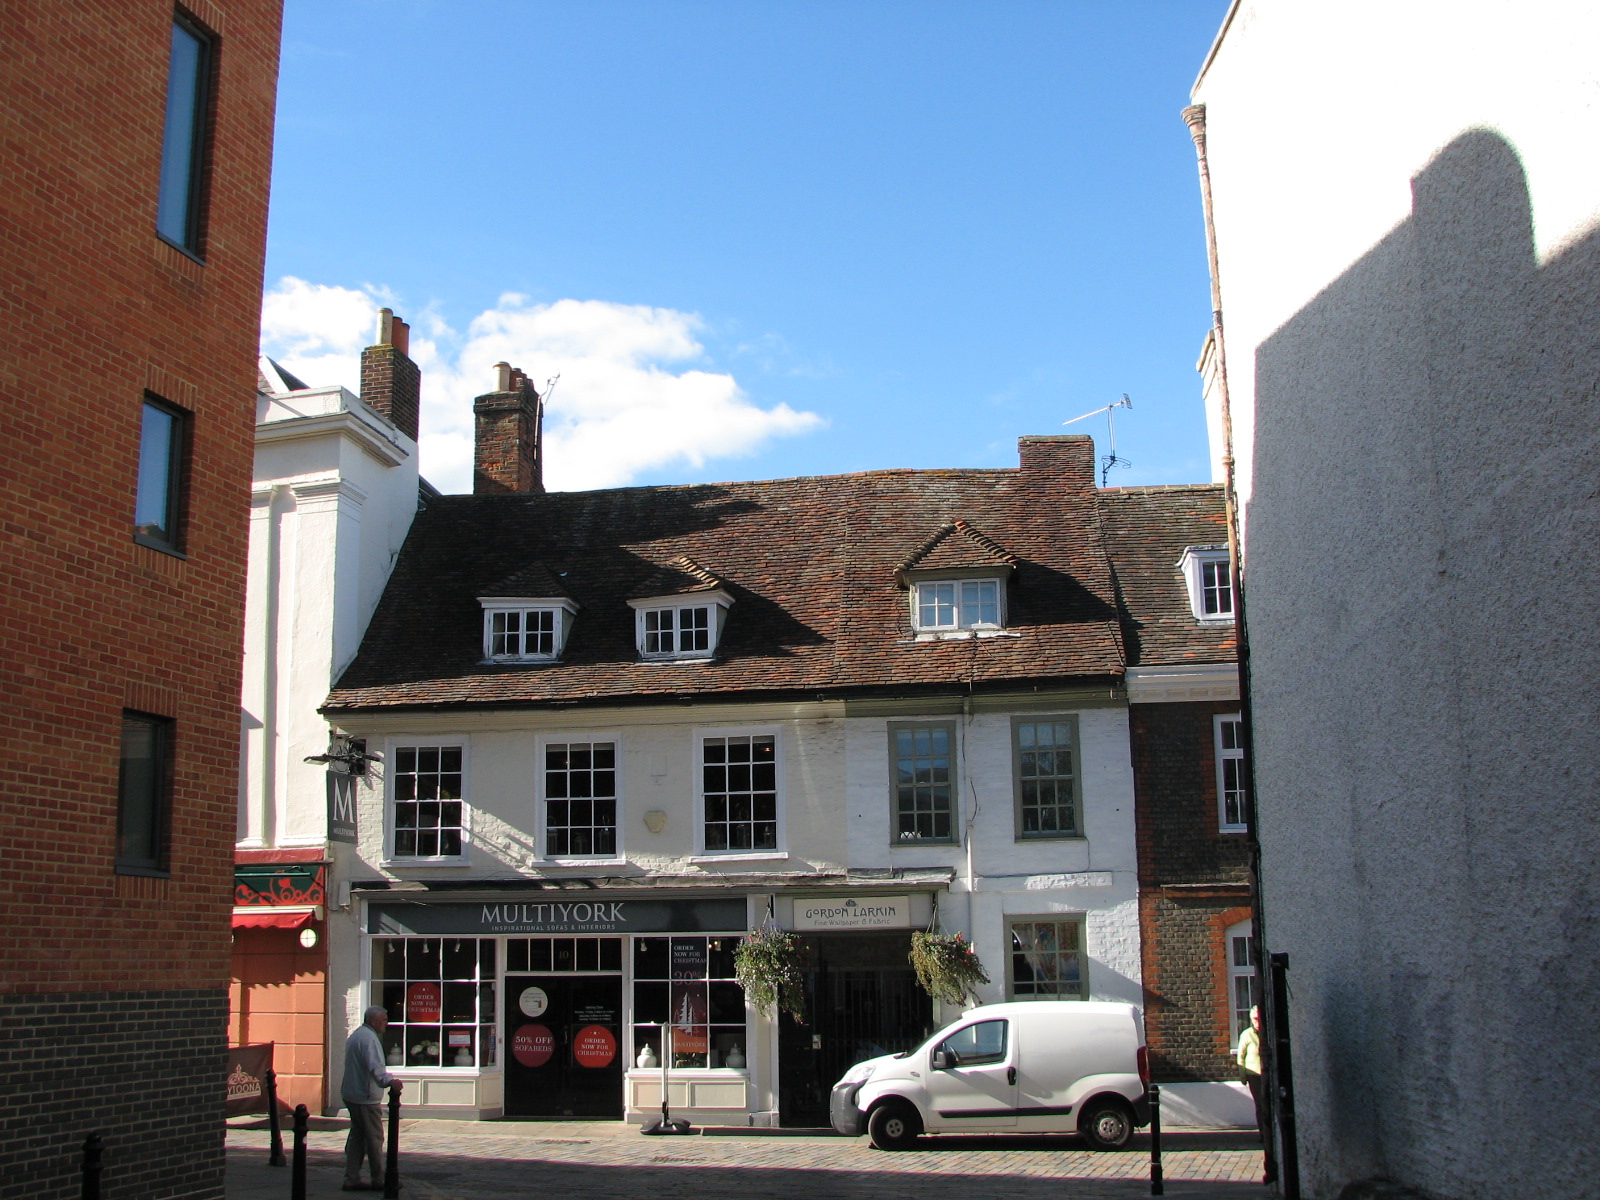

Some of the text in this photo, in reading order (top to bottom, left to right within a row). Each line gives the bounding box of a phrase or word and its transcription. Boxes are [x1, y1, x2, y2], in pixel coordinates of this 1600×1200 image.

[333, 778, 355, 823] M
[481, 902, 627, 923] MULTIYORK
[806, 906, 896, 918] GORDON LARKIN
[535, 1036, 553, 1044] OFF
[514, 1044, 553, 1052] SOFABEDS
